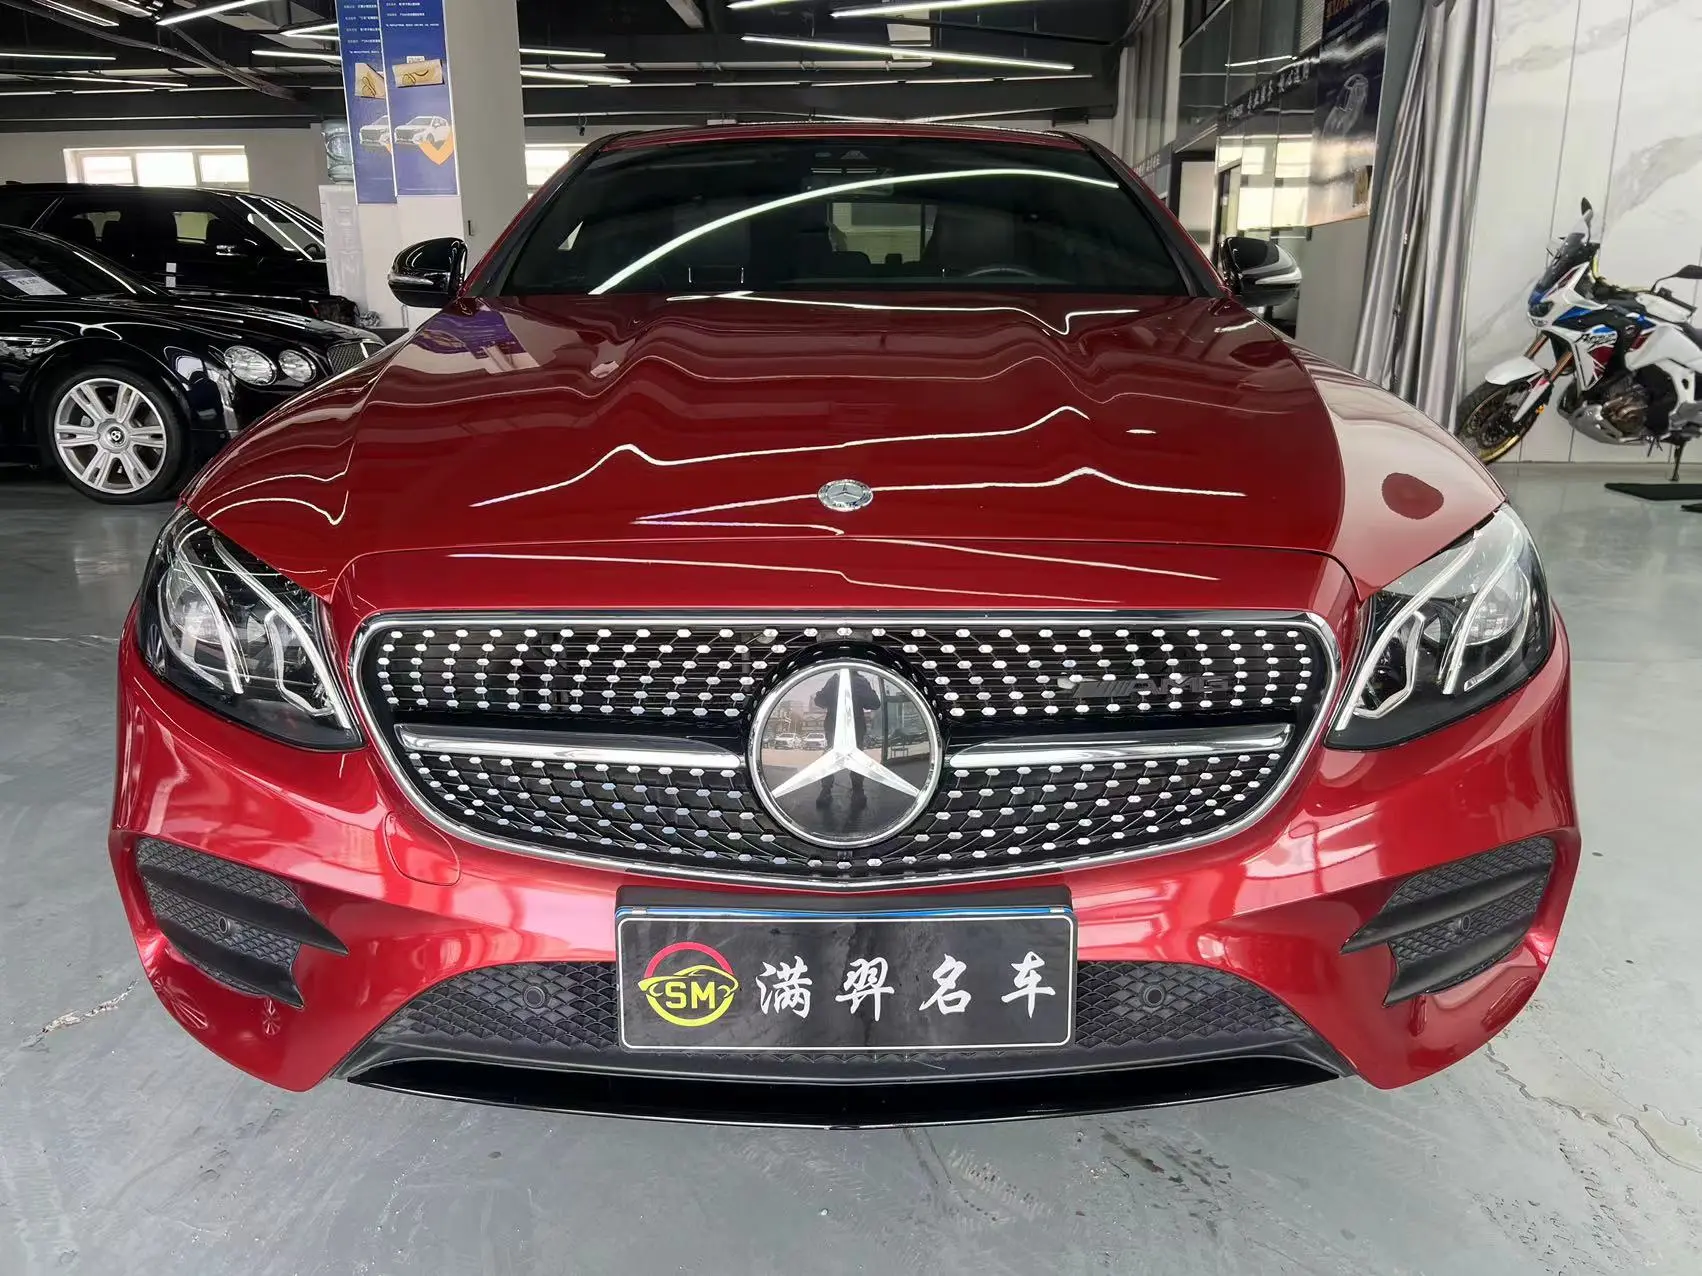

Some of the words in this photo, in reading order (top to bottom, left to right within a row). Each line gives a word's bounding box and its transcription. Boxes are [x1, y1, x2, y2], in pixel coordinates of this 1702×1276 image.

[665, 981, 715, 1009] SM
[755, 951, 1057, 1022] 满羿名车
